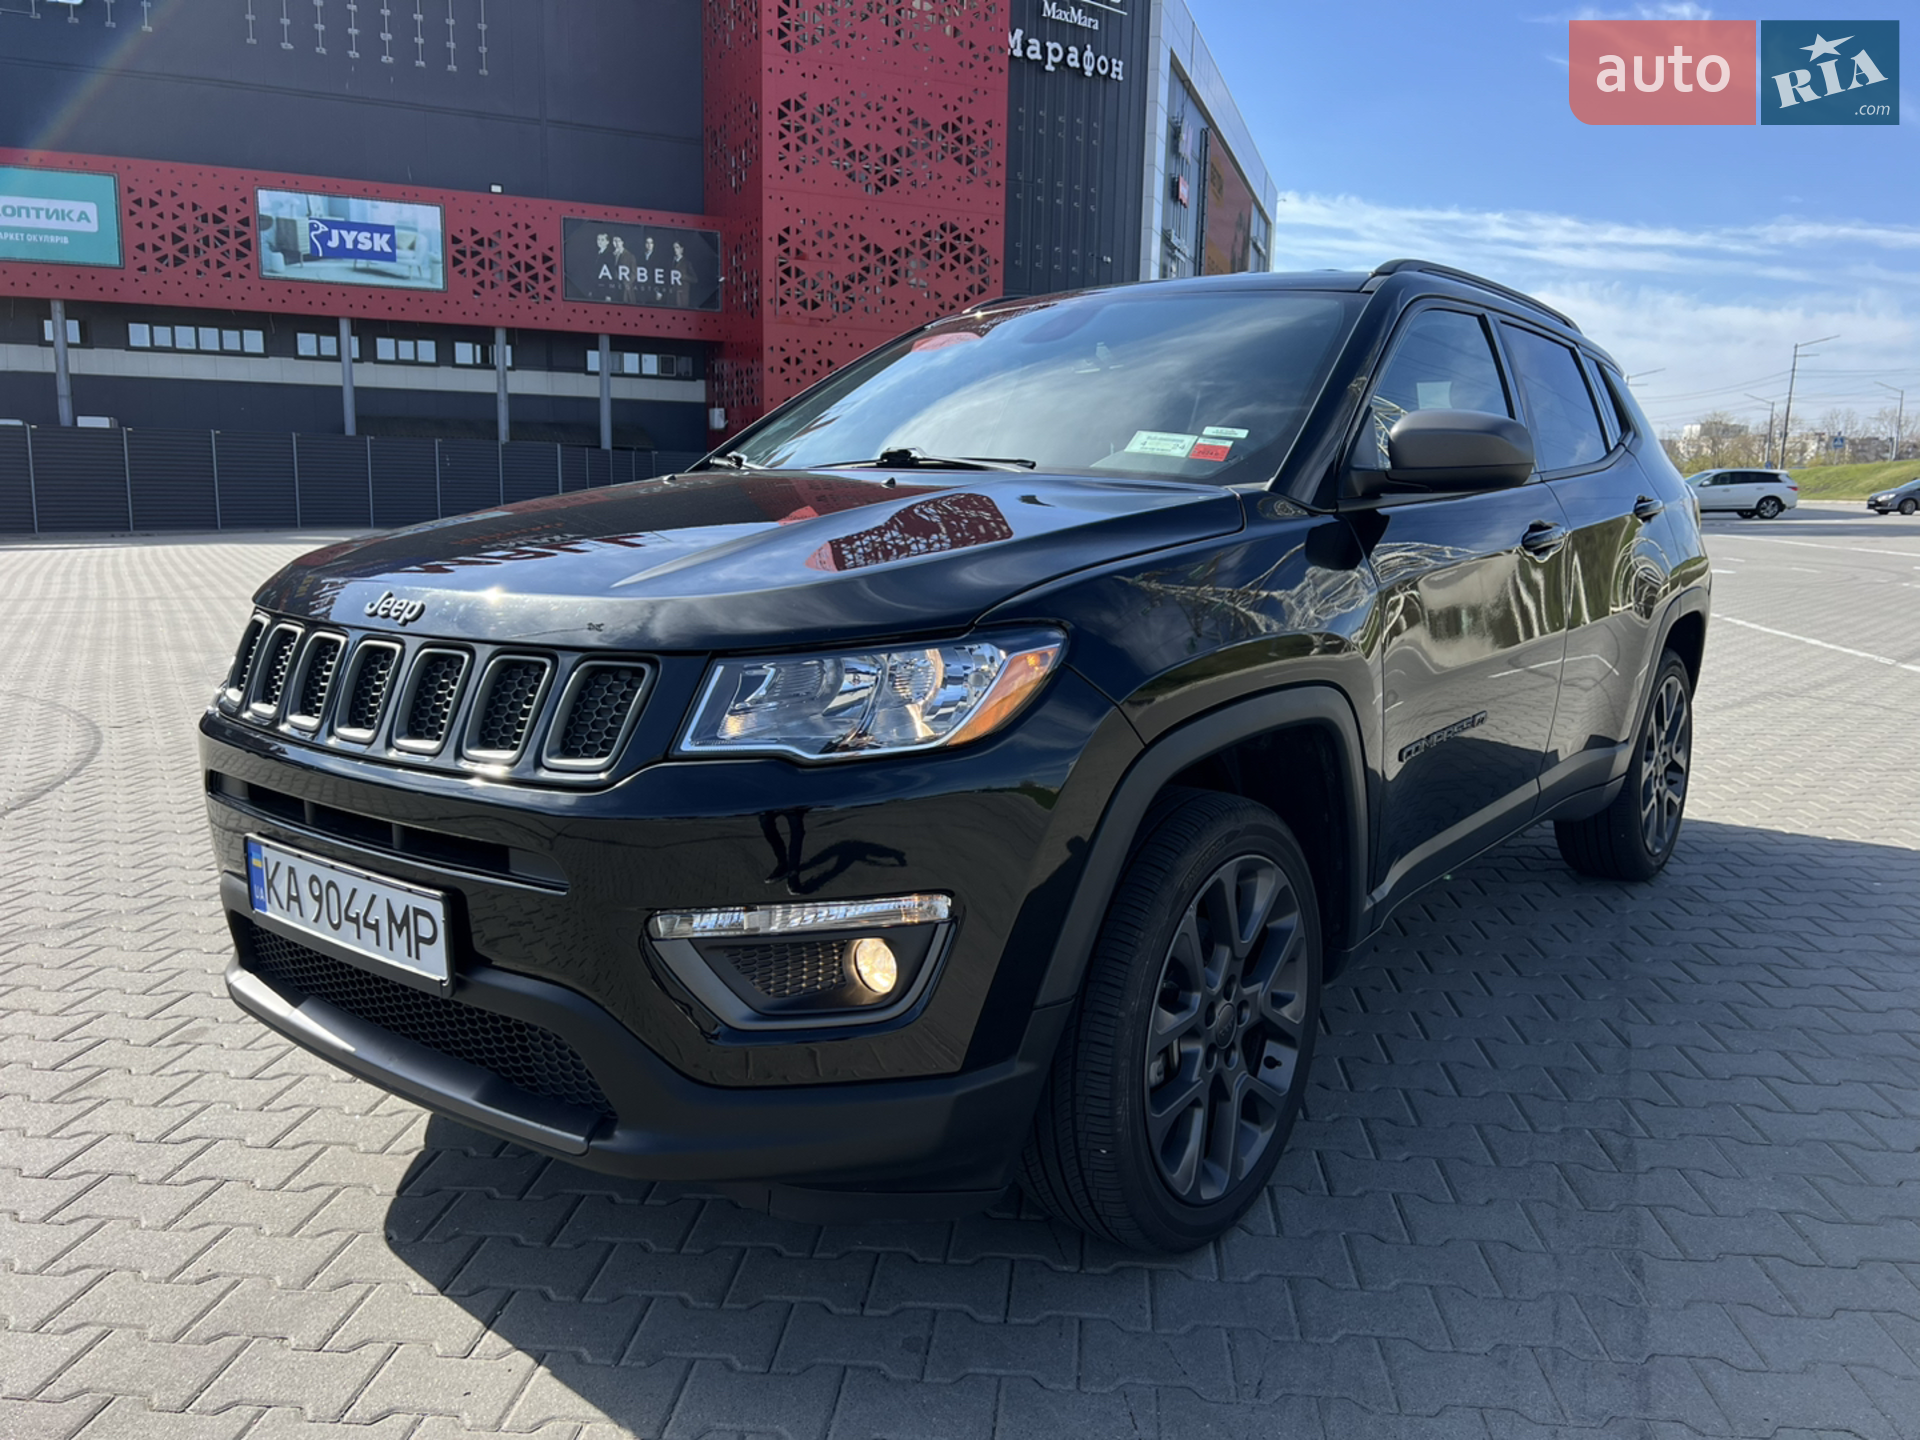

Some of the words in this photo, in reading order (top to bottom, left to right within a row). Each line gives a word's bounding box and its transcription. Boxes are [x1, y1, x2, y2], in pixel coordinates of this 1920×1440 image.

[1042, 0, 1099, 30] MaxMara
[1008, 28, 1124, 81] Марафон
[0, 204, 92, 224] ОПТИКА
[327, 229, 392, 253] JYSK
[598, 264, 682, 286] ARBER
[364, 589, 426, 627] Jeep
